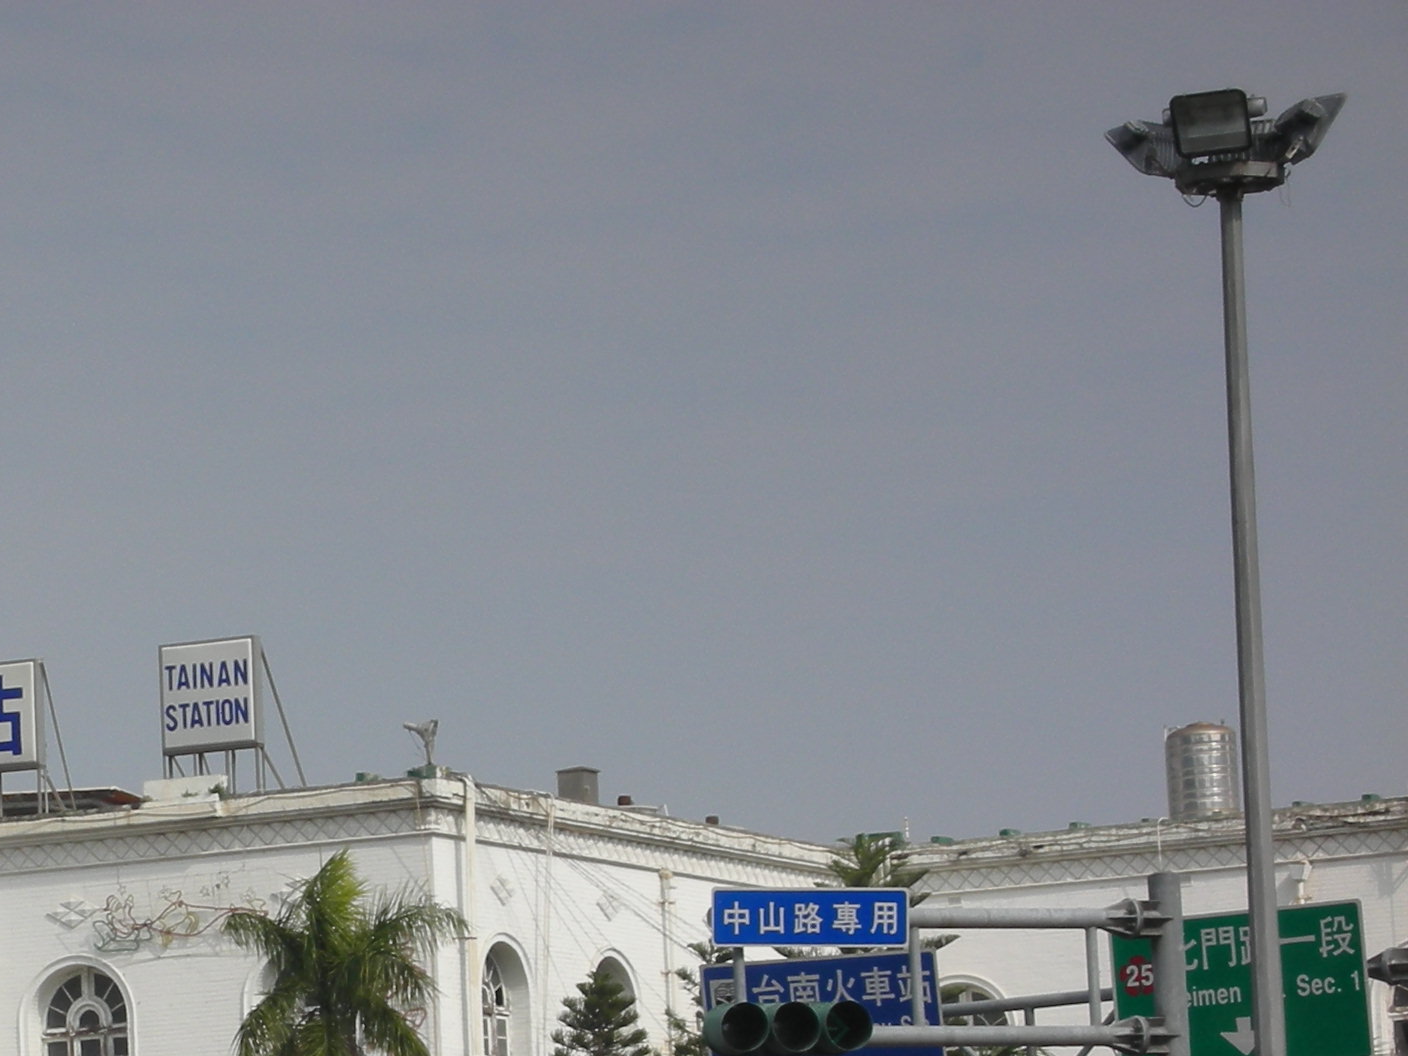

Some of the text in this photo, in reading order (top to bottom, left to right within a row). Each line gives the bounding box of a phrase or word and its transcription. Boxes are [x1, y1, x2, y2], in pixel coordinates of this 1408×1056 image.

[164, 658, 248, 691] TAINAN
[164, 697, 249, 732] STATION
[723, 901, 898, 935] 中山路專用
[1182, 915, 1355, 971] 門一段
[1296, 974, 1342, 997] Sec.
[1350, 970, 1360, 991] 1
